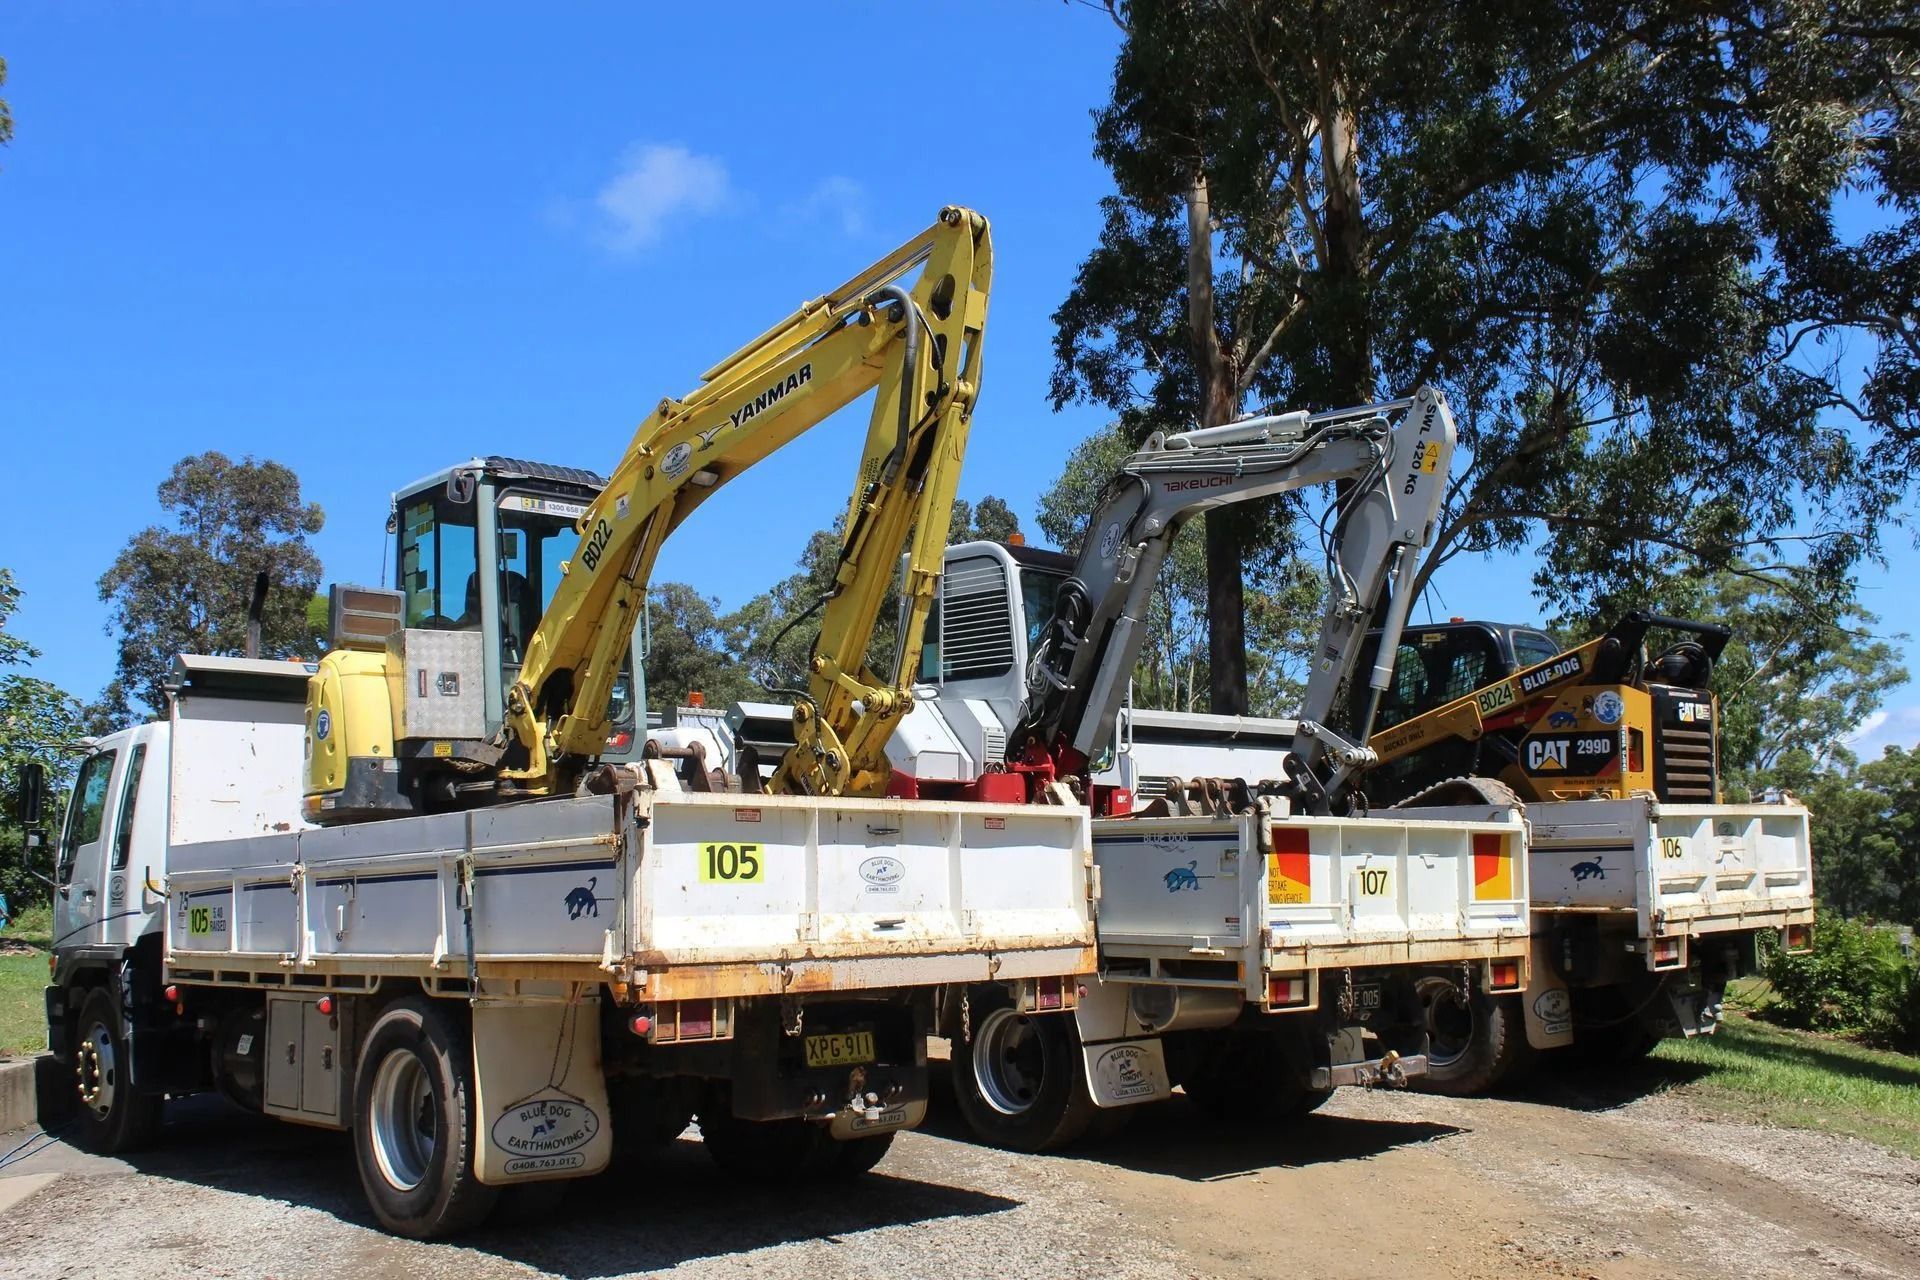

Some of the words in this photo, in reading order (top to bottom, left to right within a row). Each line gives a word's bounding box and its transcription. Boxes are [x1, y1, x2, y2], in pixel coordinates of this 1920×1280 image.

[730, 364, 812, 428] YANMAR
[1420, 404, 1437, 435] SWL
[1411, 441, 1426, 470] 420
[1163, 475, 1232, 491] TAKEUCHI
[1403, 474, 1418, 495] KG
[548, 503, 564, 511] 1300
[582, 518, 613, 572] BD22
[1523, 671, 1552, 692] BLUE
[1555, 657, 1580, 678] DOG
[1479, 682, 1513, 713] BD24
[1408, 729, 1425, 743] ONLY
[1528, 740, 1570, 769] CAT
[1577, 739, 1610, 754] 299D
[1144, 832, 1163, 843] BLUE
[1169, 831, 1189, 842] DOG
[1663, 838, 1682, 858] 106
[706, 845, 759, 879] 105
[1268, 880, 1287, 892] ERTAKE
[1361, 870, 1388, 895] 107
[191, 908, 208, 933] 105
[1363, 990, 1379, 1006] 005
[1110, 1050, 1125, 1062] BLUE
[520, 1105, 547, 1122] BLUE
[550, 1105, 572, 1118] DOG
[507, 1129, 585, 1151] EARTHMOVING
[512, 1156, 577, 1171] 0408.763.012
